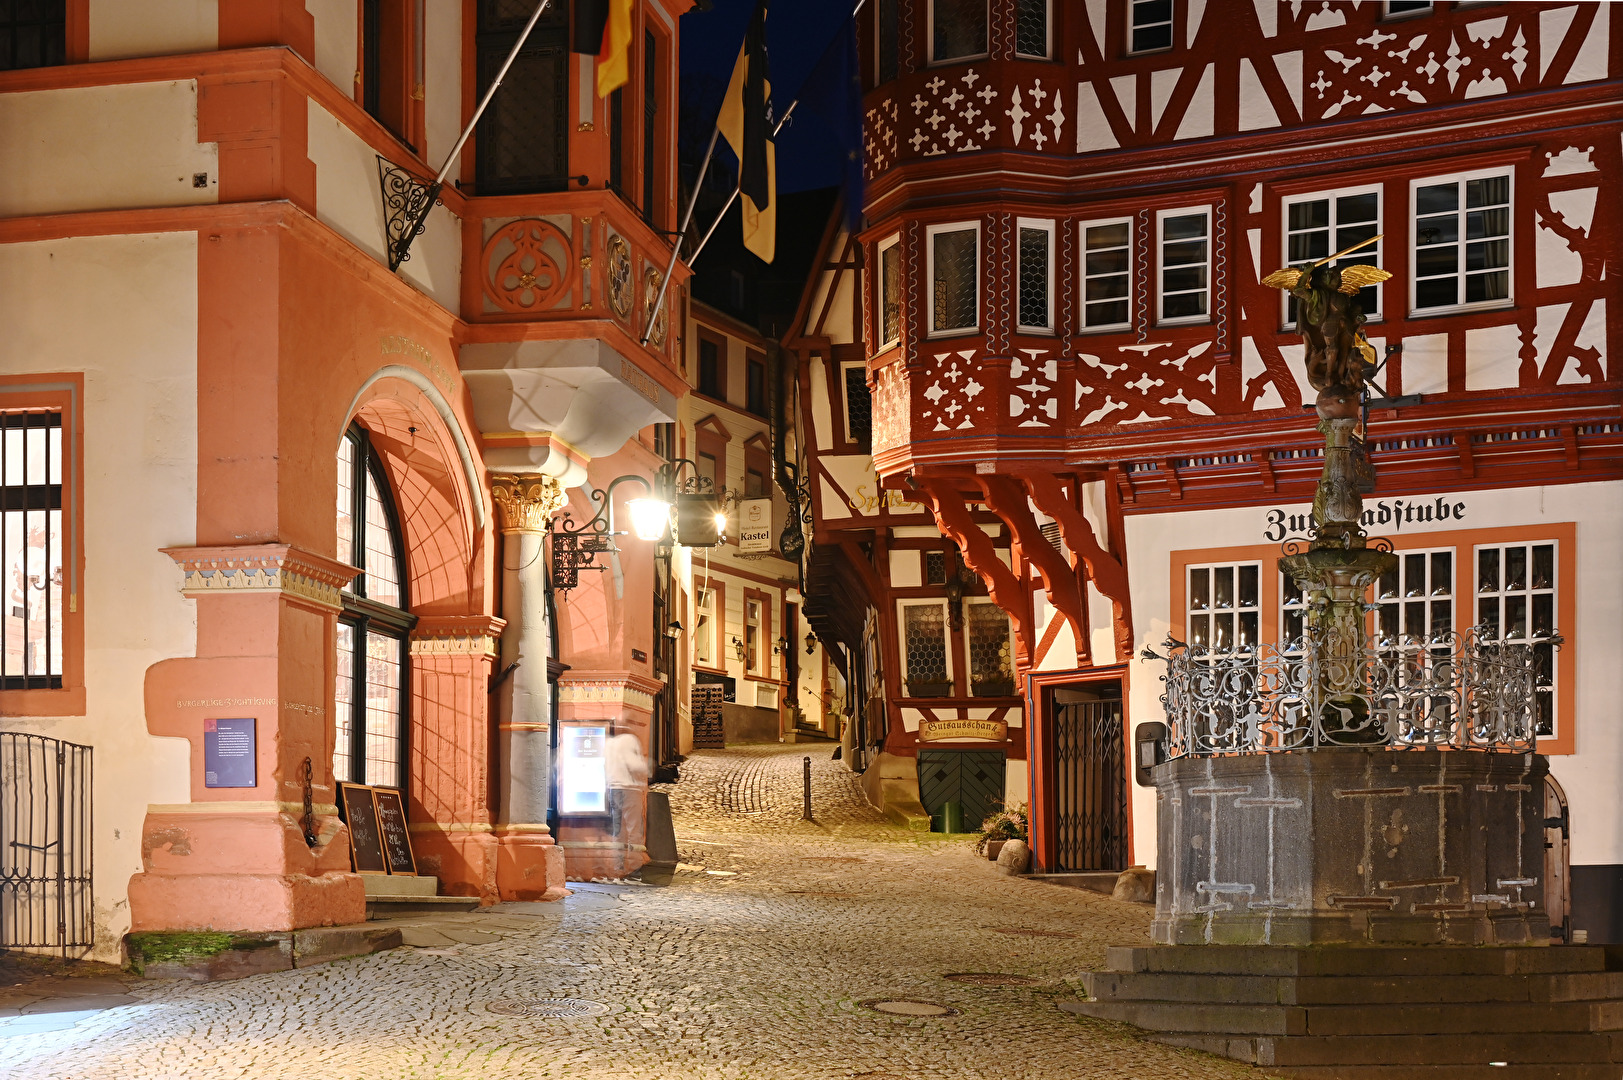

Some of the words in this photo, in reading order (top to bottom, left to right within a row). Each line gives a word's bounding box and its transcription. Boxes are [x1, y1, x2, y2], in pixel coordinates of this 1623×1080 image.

[1359, 496, 1466, 532] adstube
[740, 530, 769, 541] Kastel
[927, 720, 998, 732] Gutsausschank
